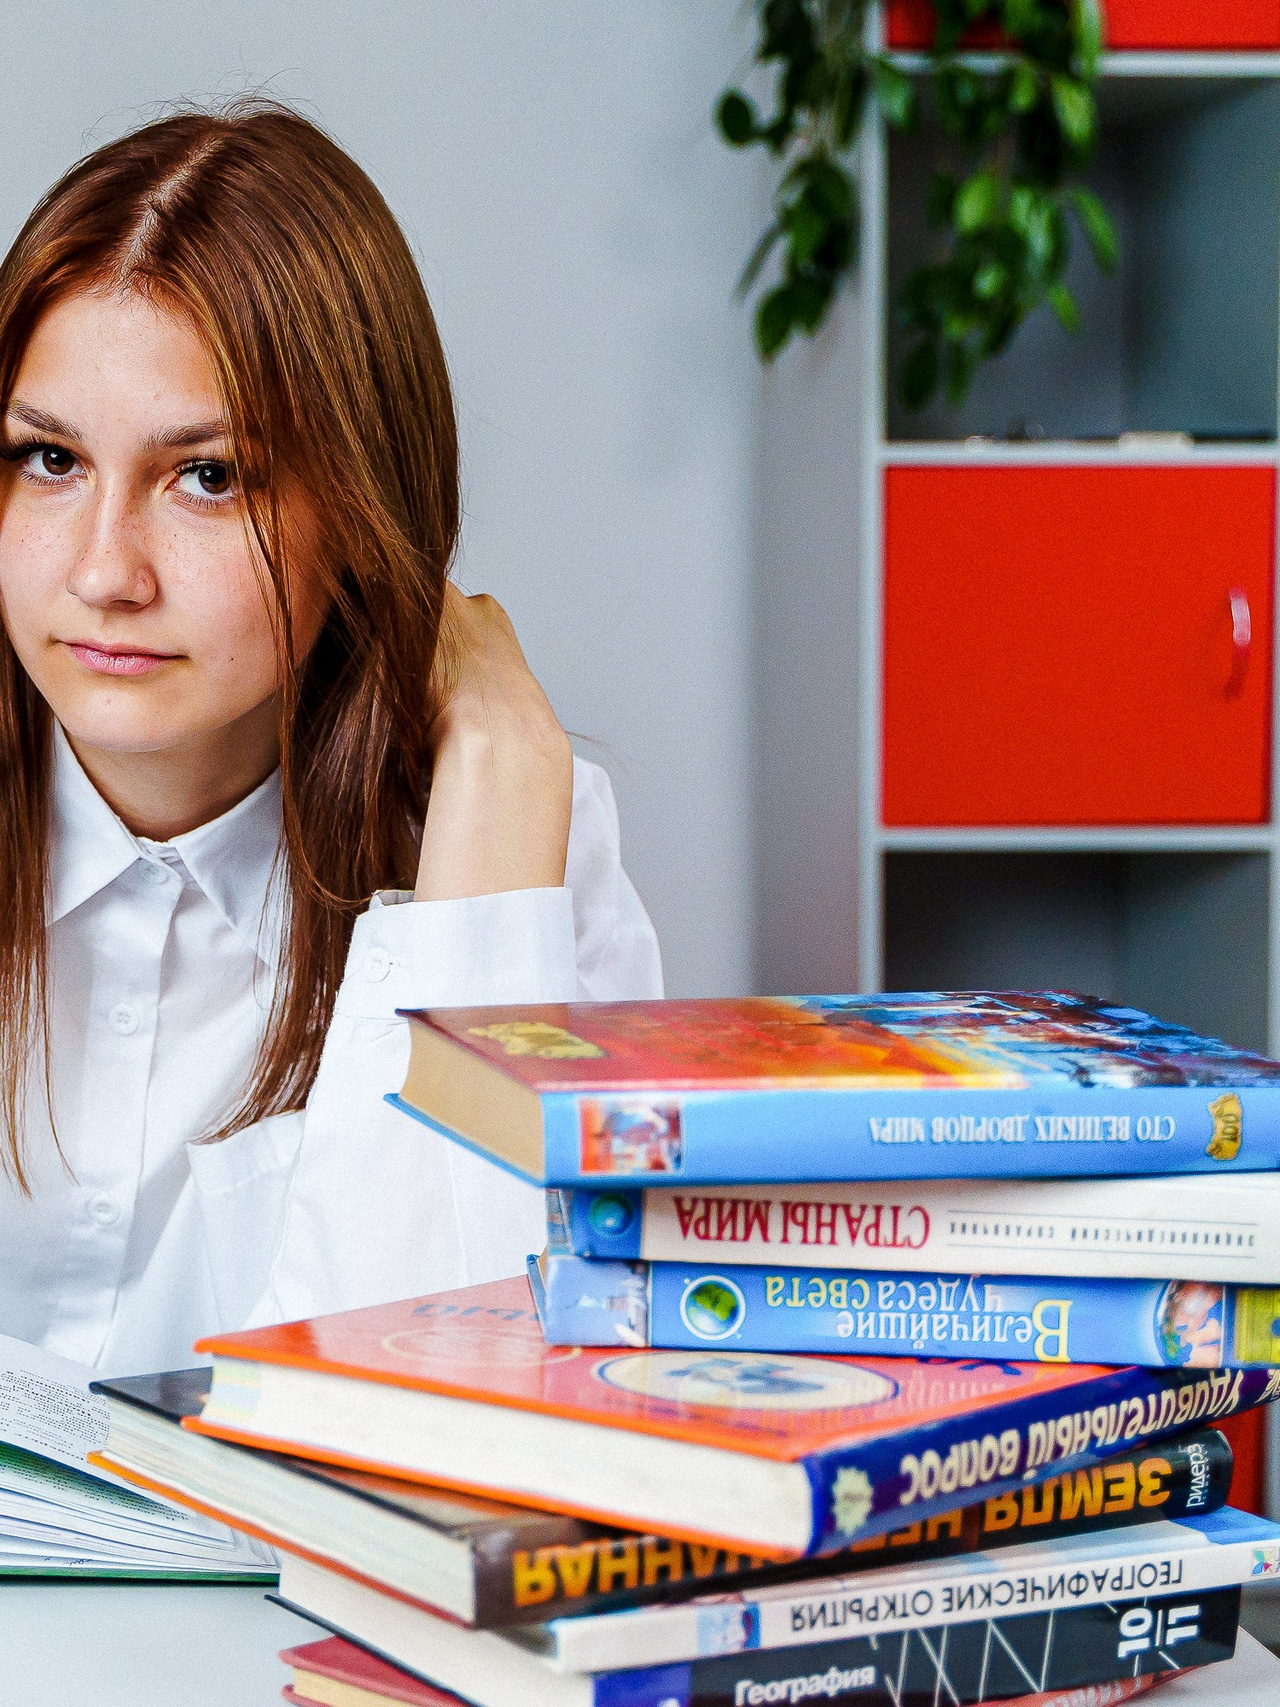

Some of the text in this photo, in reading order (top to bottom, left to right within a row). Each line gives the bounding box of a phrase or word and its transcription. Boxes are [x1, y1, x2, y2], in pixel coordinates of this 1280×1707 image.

[869, 1112, 1176, 1145] СТО ВЕЛИКИХ ДВОРЦОВ МИРА
[671, 1195, 931, 1251] СТРАНЫ МИРА
[764, 1275, 1003, 1314] чудеса света
[982, 1457, 1173, 1533] ЗЕМЛЯ
[790, 1559, 1184, 1632] ГЕОГРАФИЧЕСКИЕ ОТКРЫТИЯ
[1117, 1607, 1153, 1658] 10
[1166, 1604, 1200, 1645] 11
[734, 1664, 876, 1707] География
